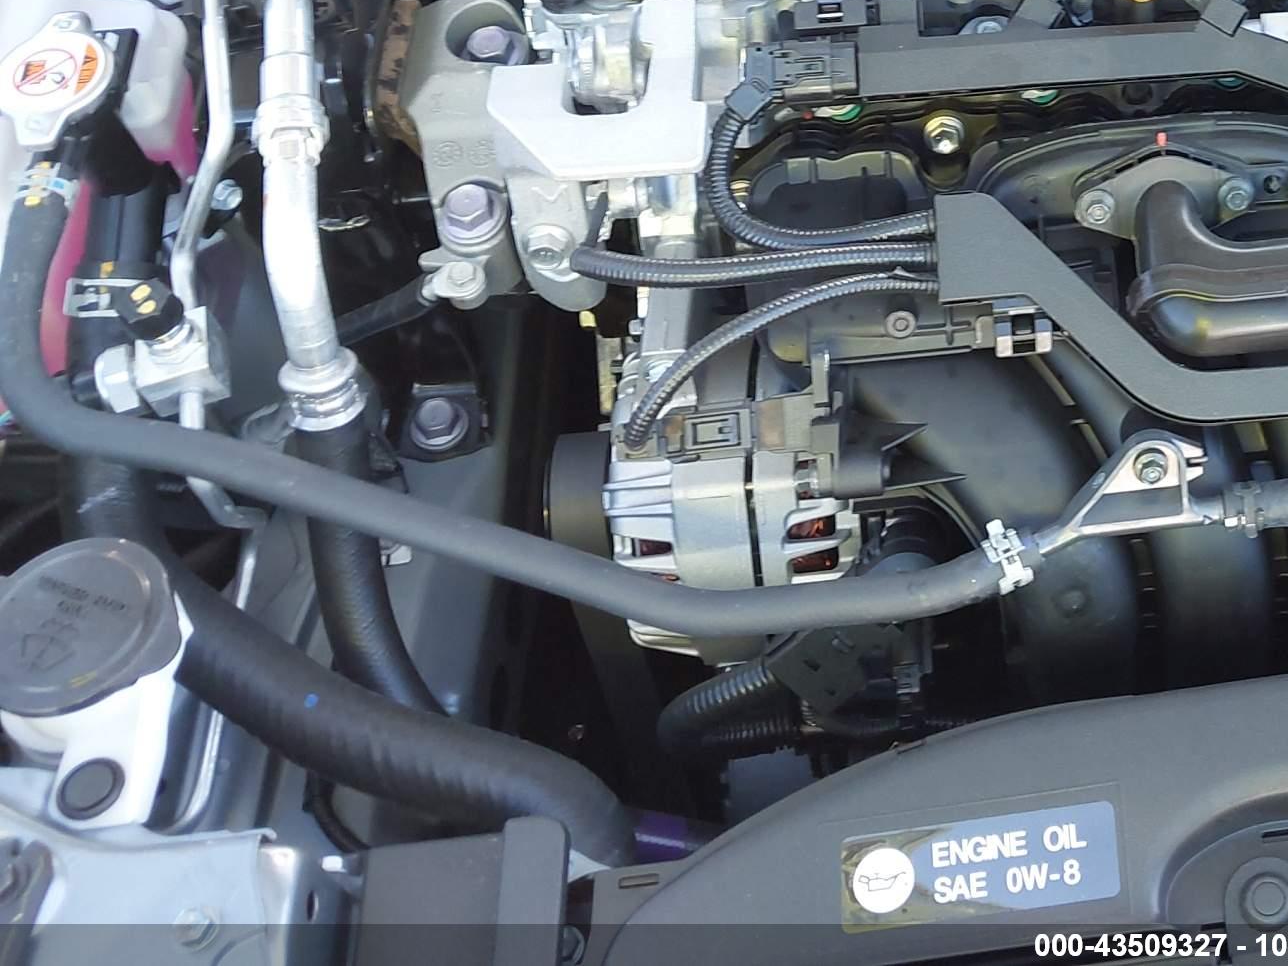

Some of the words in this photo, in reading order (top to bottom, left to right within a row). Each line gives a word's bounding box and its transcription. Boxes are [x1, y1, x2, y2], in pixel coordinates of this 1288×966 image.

[931, 830, 1027, 868] ENGINE
[1043, 823, 1087, 852] OIL
[933, 871, 988, 904] SAE
[1006, 859, 1082, 893] 0W-8
